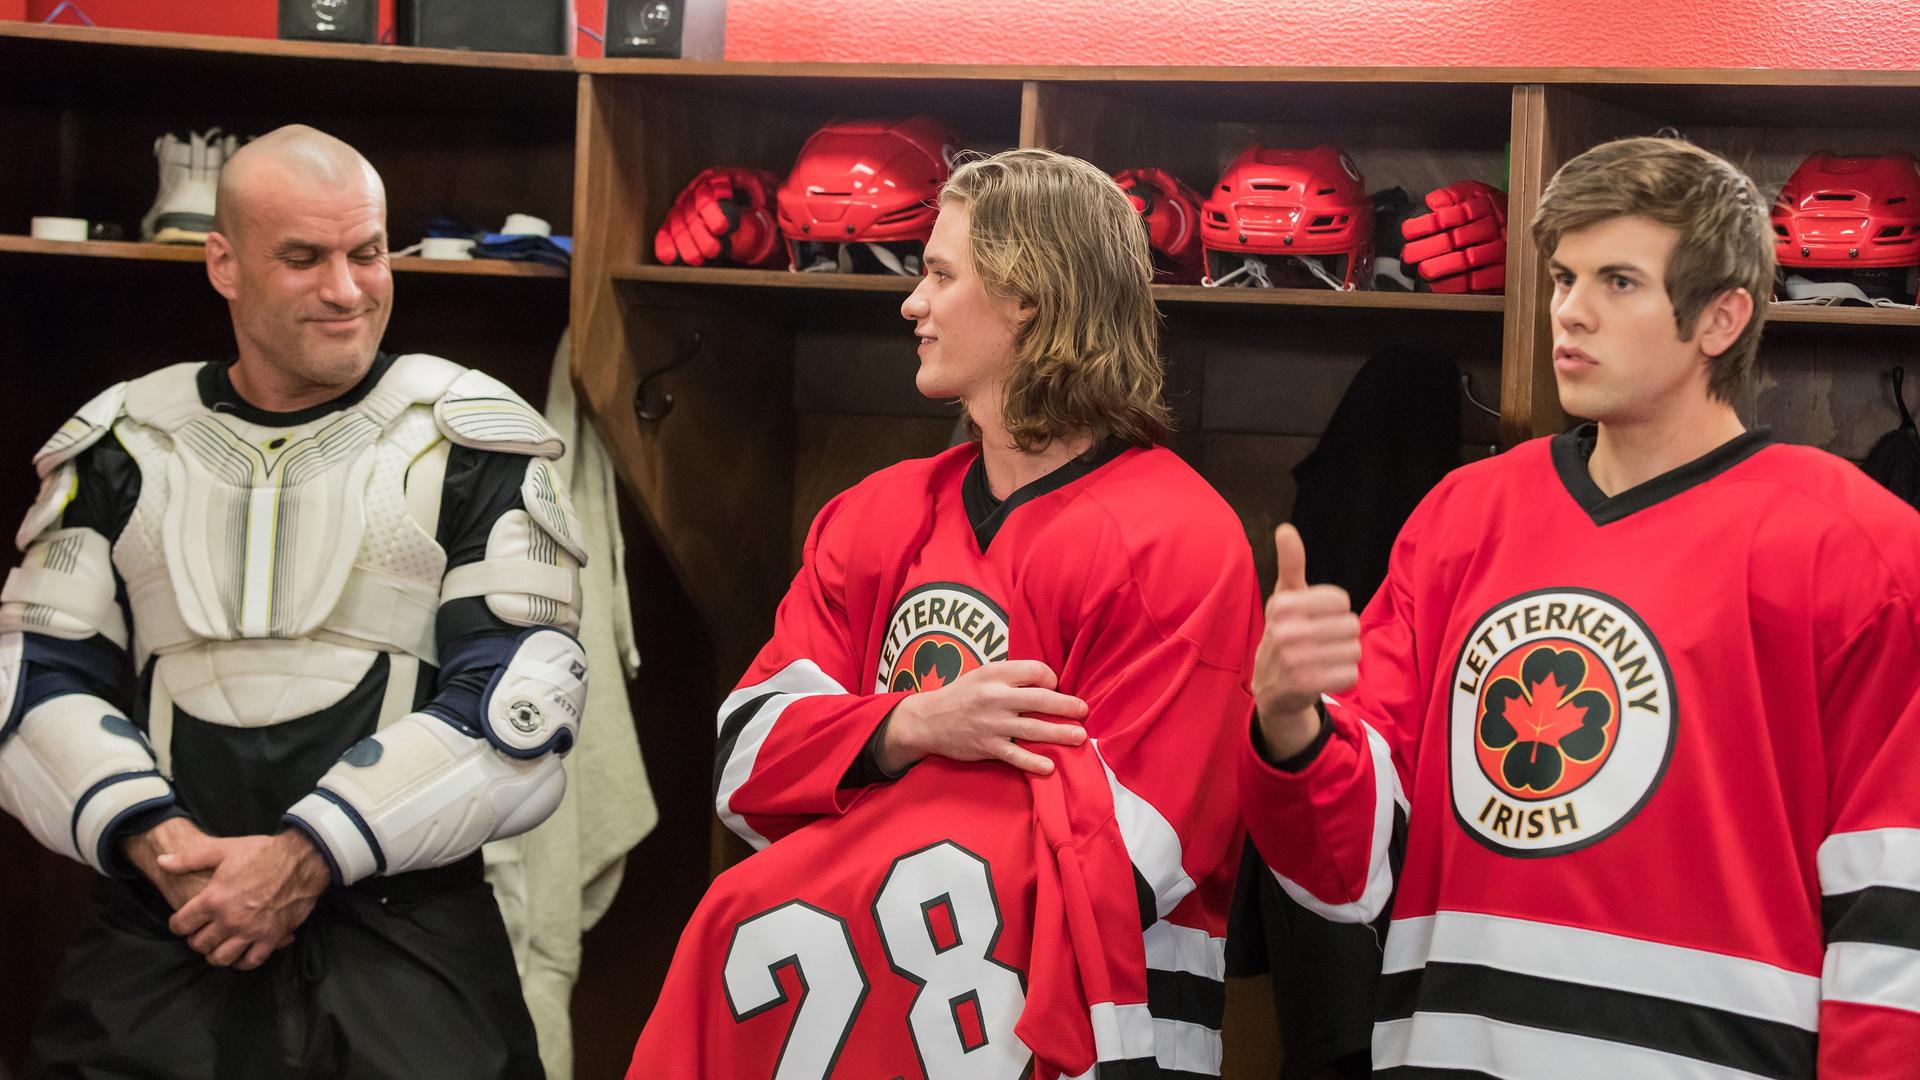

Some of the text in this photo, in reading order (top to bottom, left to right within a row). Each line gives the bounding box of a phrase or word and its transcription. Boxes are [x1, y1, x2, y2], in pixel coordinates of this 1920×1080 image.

[1459, 603, 1659, 714] LETTERKENNY
[1478, 797, 1579, 838] IRISH
[722, 839, 1034, 1080] 28
